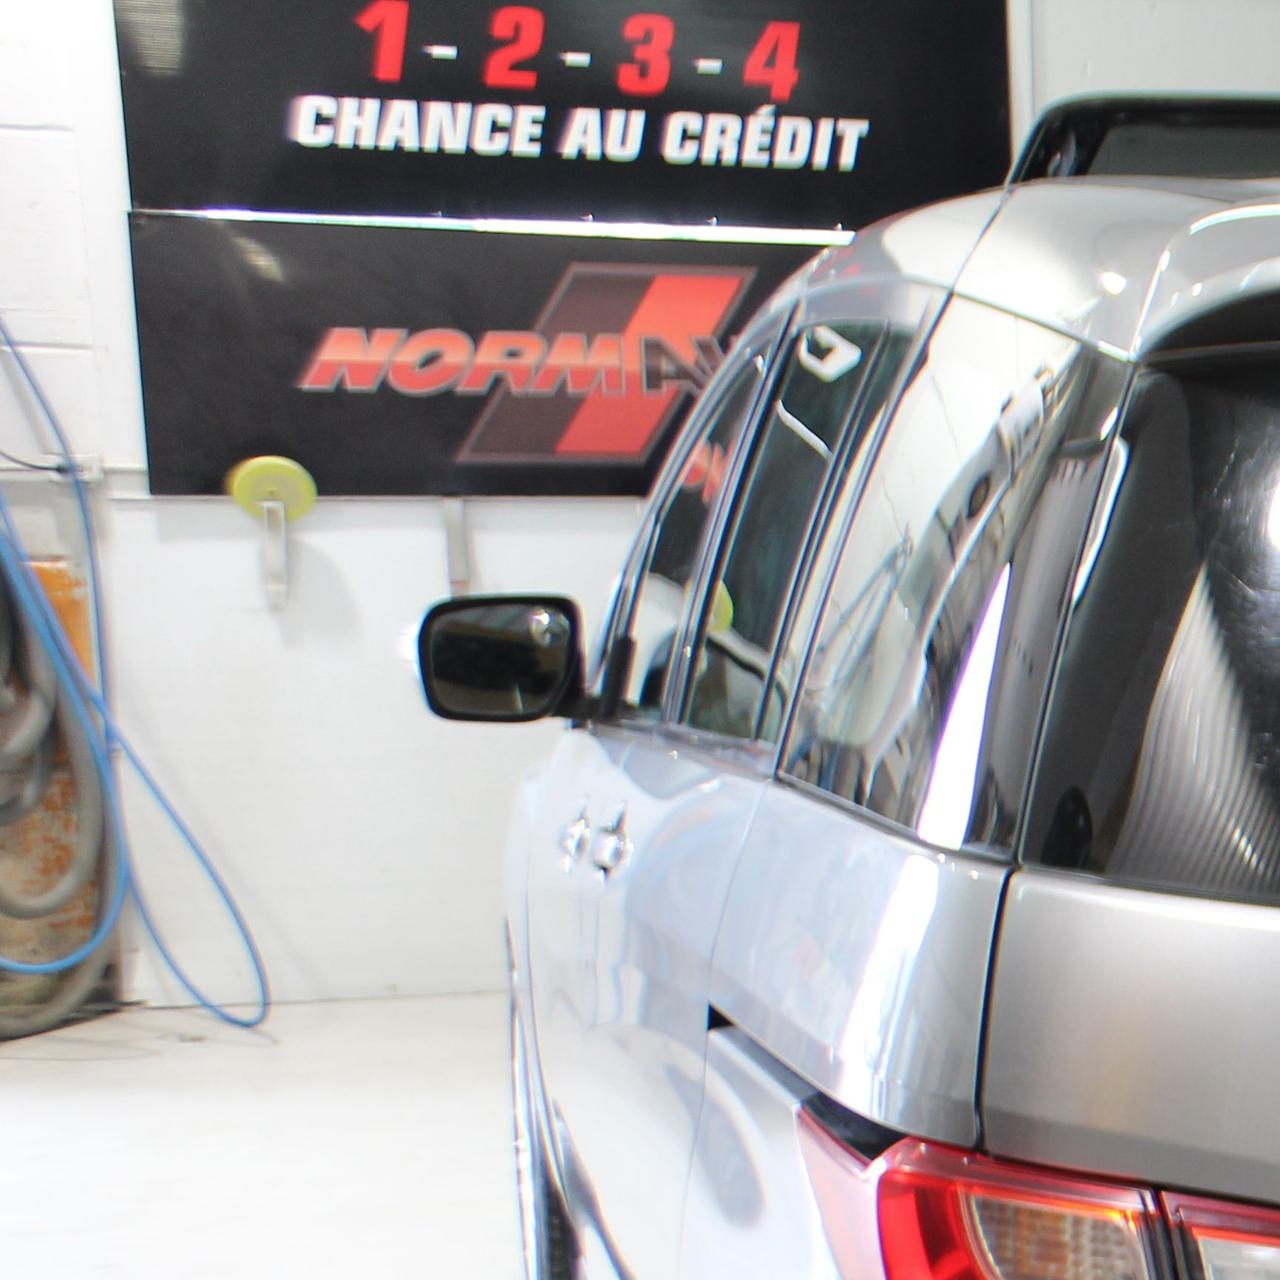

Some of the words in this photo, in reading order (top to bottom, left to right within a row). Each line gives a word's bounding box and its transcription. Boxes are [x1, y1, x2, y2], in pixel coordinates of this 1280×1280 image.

[292, 94, 546, 158] CHANCE
[559, 107, 646, 162] AU
[661, 104, 869, 172] CRÉDIT
